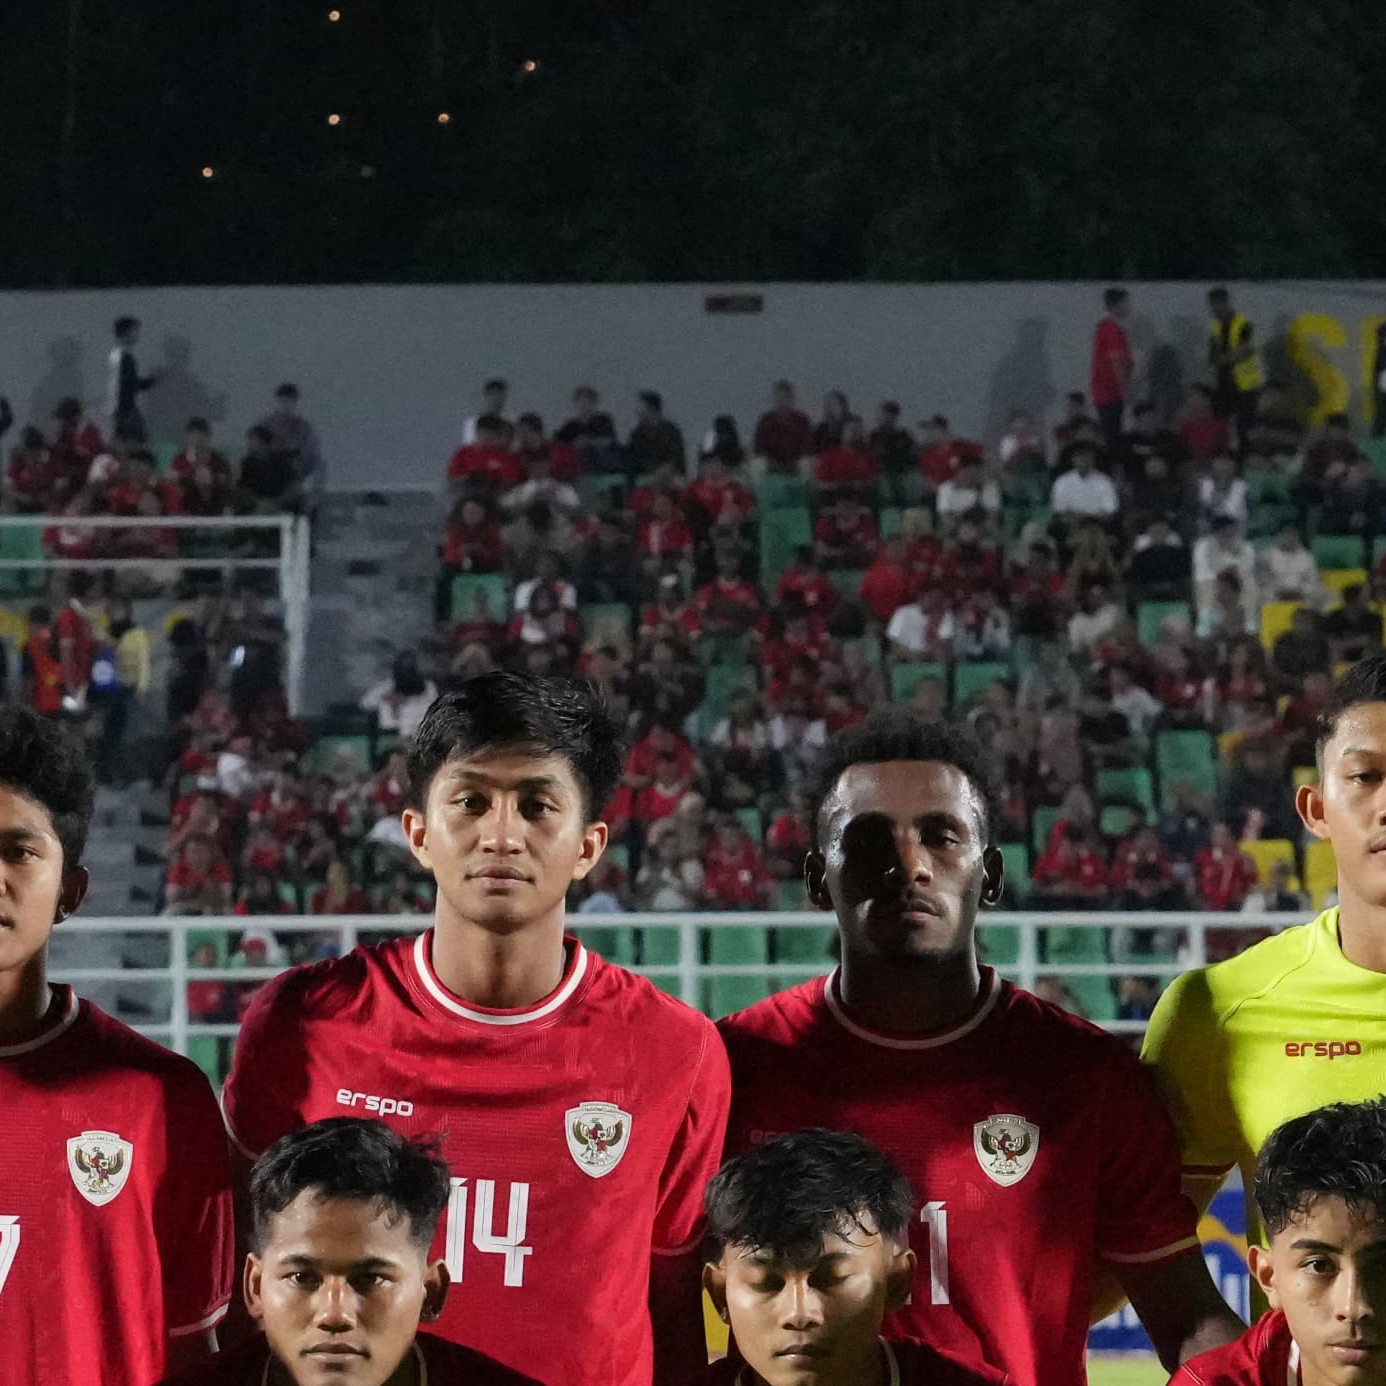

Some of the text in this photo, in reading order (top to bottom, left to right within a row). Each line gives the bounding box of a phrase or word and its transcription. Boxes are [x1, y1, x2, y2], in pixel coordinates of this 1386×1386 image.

[1285, 1040, 1361, 1060] erspo
[336, 1088, 413, 1117] erspo
[446, 1177, 533, 1287] 14
